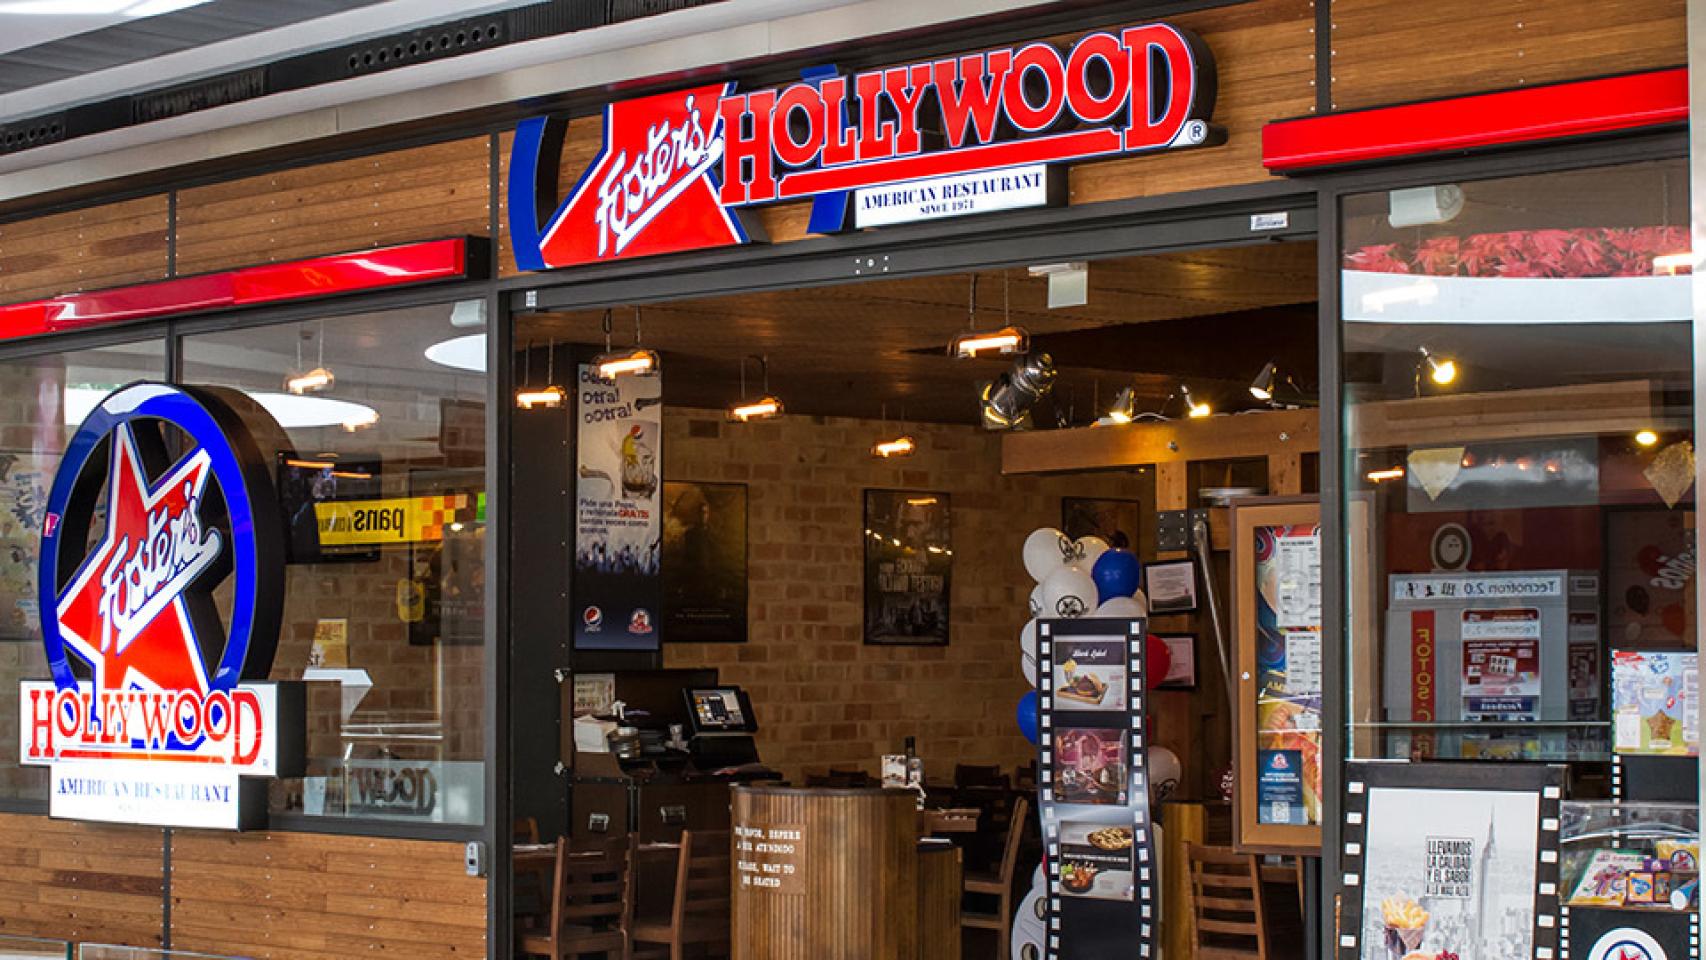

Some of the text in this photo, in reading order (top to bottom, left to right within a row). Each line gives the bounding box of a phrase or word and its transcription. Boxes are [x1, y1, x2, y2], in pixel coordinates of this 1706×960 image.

[720, 23, 1195, 206] HOLLYWOOD
[595, 94, 722, 257] Foster's
[862, 172, 1042, 210] AMERICAN RESTAURANT
[920, 201, 950, 215] SINCE
[99, 481, 222, 655] Foster's
[29, 688, 264, 766] HOLLYWOOD
[1428, 840, 1471, 855] LLEVAMOS
[1439, 856, 1470, 869] CALIDAD
